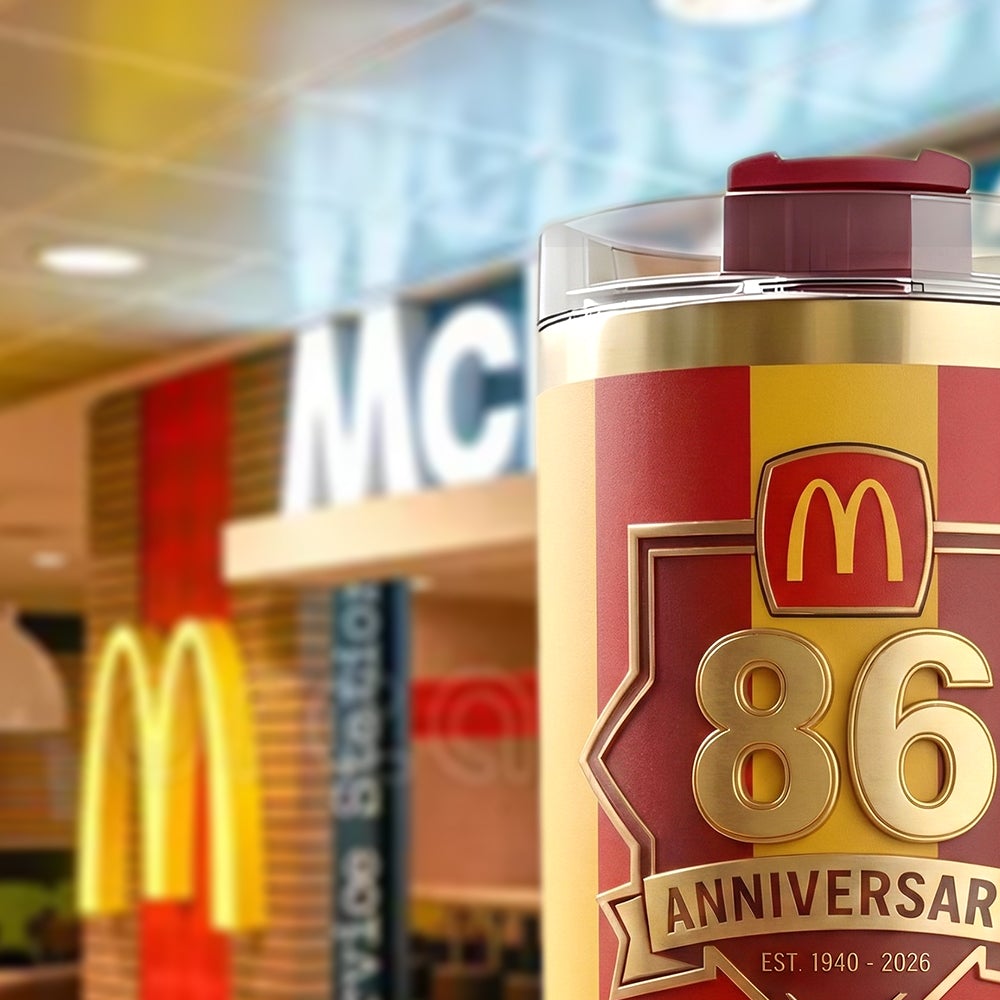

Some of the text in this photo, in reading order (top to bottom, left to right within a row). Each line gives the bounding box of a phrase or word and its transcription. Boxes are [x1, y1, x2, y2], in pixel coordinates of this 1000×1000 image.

[692, 627, 997, 843] 86
[761, 952, 802, 972] EST.
[812, 951, 859, 972] 1940
[881, 951, 931, 972] 2026
